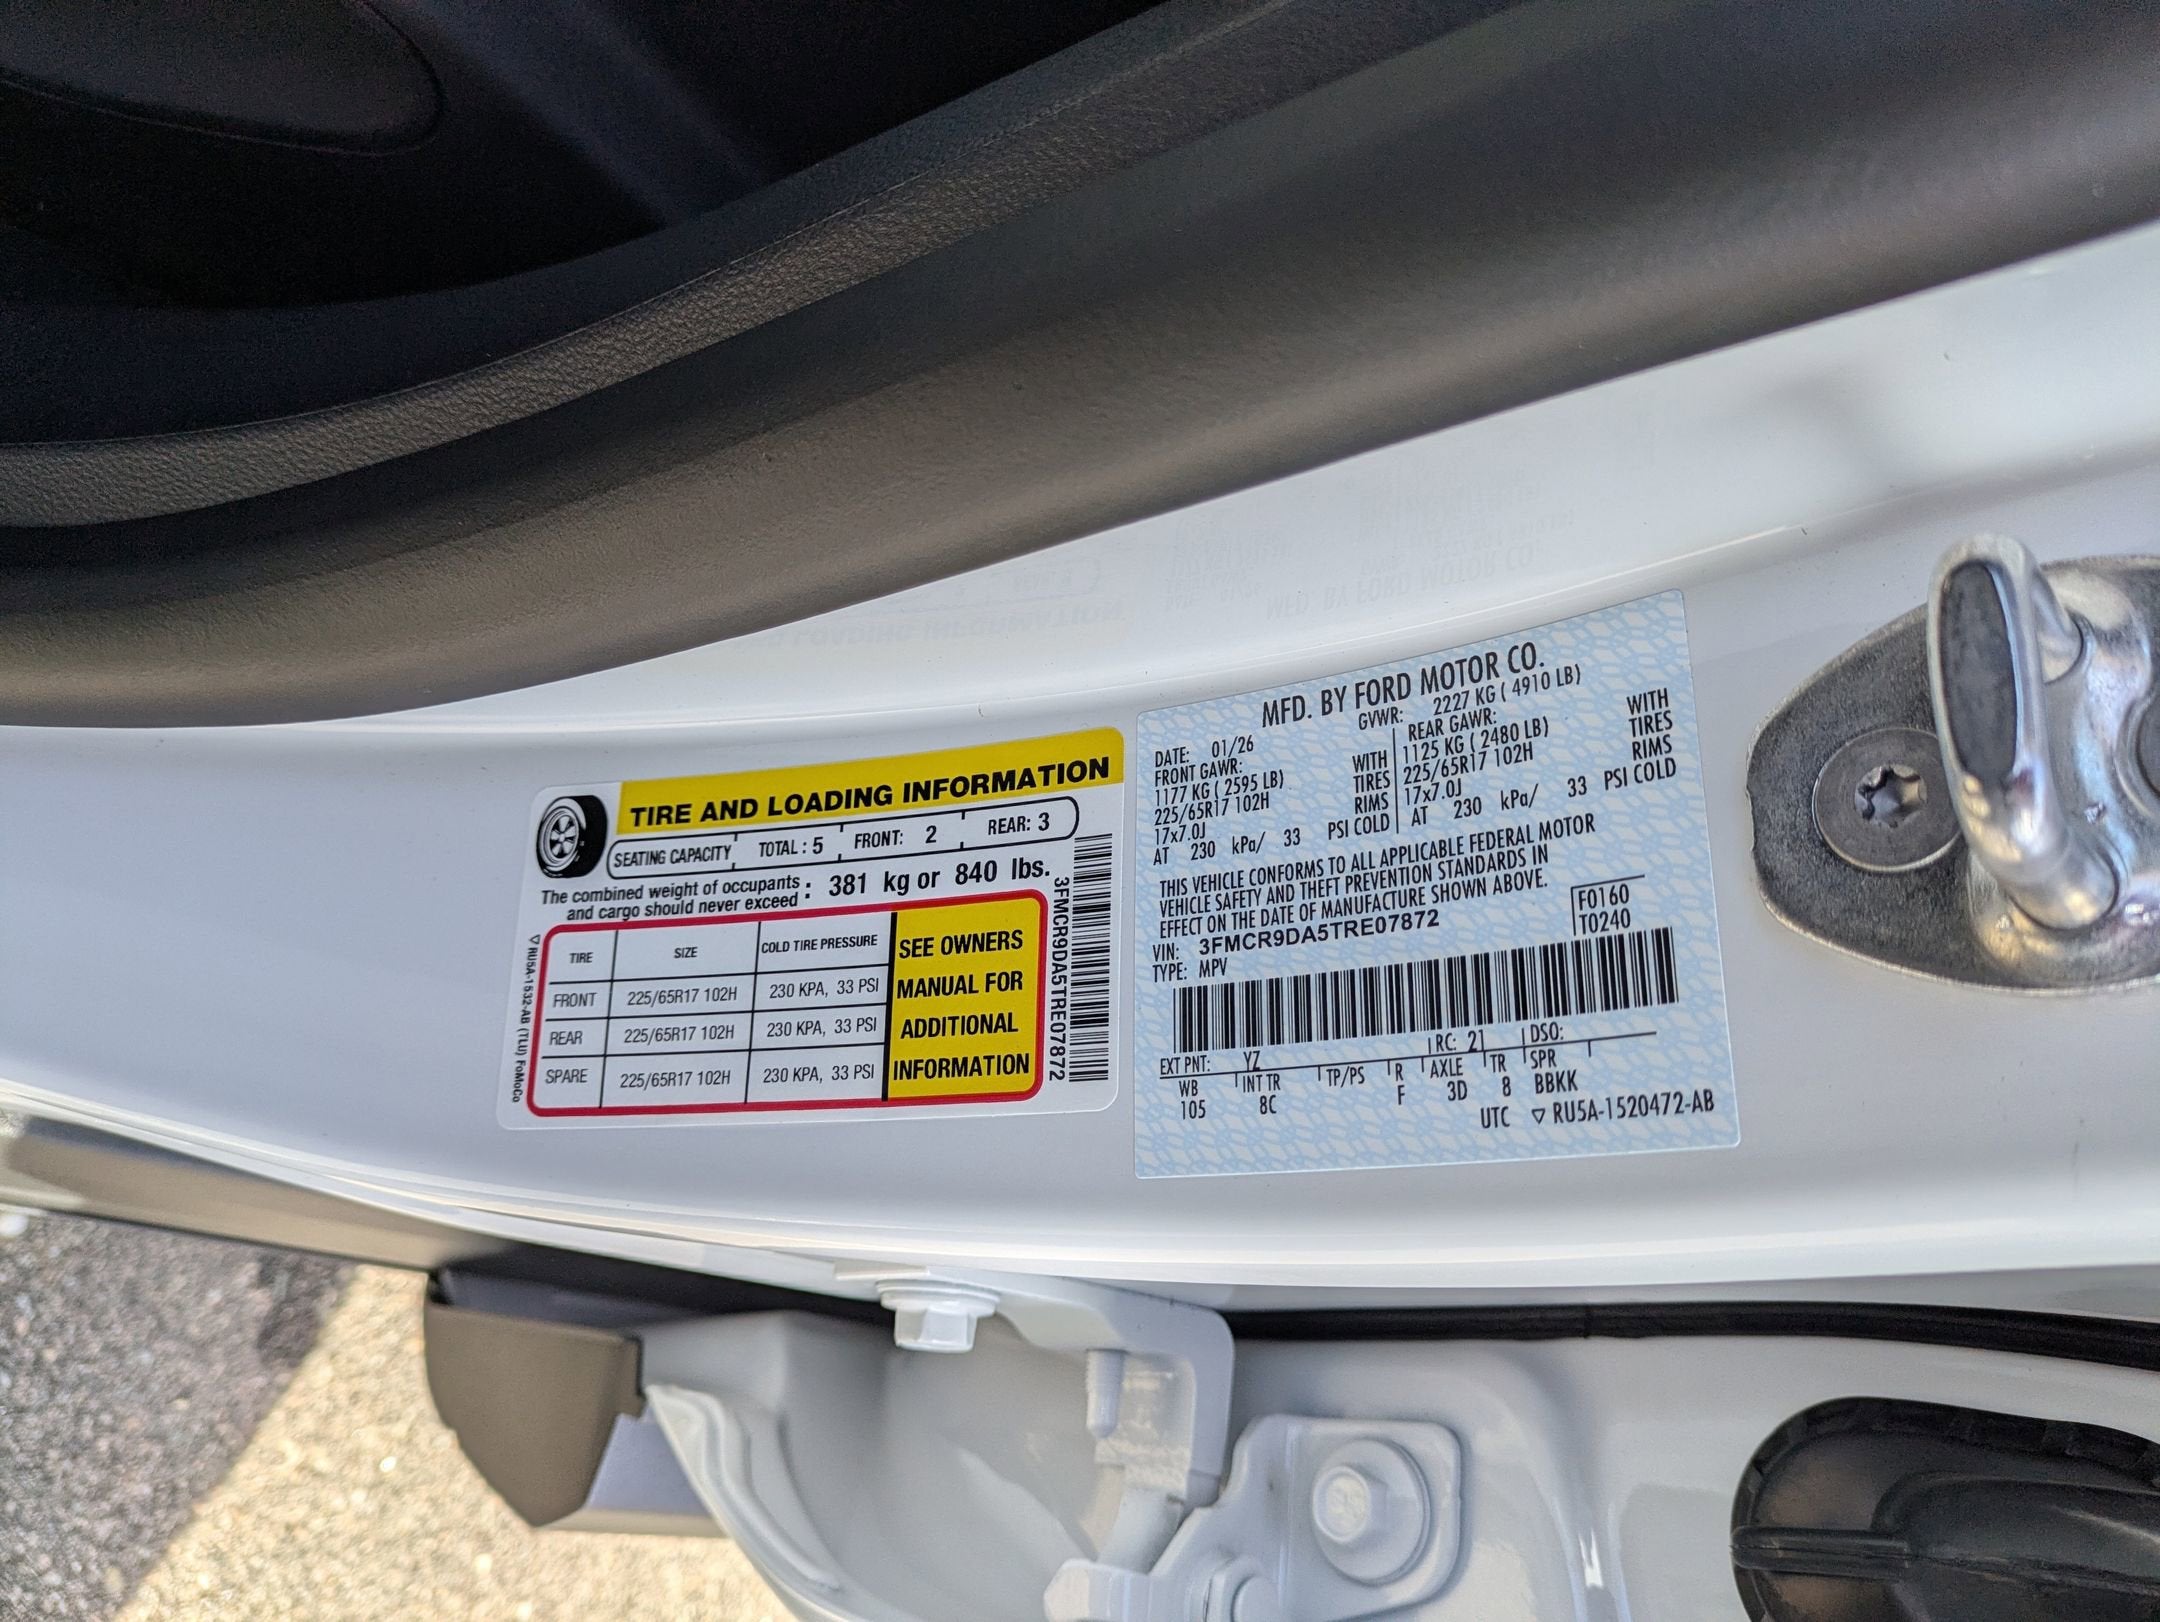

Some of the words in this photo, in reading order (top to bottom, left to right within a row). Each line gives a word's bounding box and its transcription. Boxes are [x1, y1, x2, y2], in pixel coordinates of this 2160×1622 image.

[1262, 695, 1312, 728] MFD.
[1321, 685, 1347, 716] BY
[1355, 672, 1411, 709] FORD
[1420, 652, 1500, 696] MOTOR
[1507, 642, 1544, 674] CO.
[1358, 706, 1403, 730] GVWR:
[1433, 690, 1470, 716] 2227
[1475, 685, 1496, 706] KG
[1556, 663, 1581, 687] LB)
[1626, 687, 1669, 715] WITH
[1403, 739, 1439, 764] 1125
[1445, 735, 1464, 756] KG
[1524, 716, 1549, 739] LB)
[1408, 718, 1445, 742] REAR
[1449, 707, 1497, 733] GAWR:
[1628, 710, 1673, 738] TIRES
[1155, 746, 1190, 768] DATE:
[1211, 734, 1254, 758] 01/26
[1352, 749, 1387, 773] WITH
[1403, 750, 1487, 785] 225/65R17
[1494, 741, 1533, 767] 102H
[1632, 734, 1672, 761] RIMS
[1155, 764, 1196, 787] FRONT
[1200, 757, 1243, 780] GAWR:
[1155, 785, 1188, 807] 1177
[1192, 782, 1210, 801] KG
[1263, 769, 1284, 790] LB)
[1353, 770, 1391, 794] TIRES
[1453, 796, 1482, 819] 230
[1500, 783, 1539, 811] kPa/
[1567, 775, 1587, 798] 33
[1604, 766, 1628, 791] PSI
[1634, 757, 1676, 784] COLD
[630, 803, 692, 827] TIRE
[699, 798, 759, 822] AND
[767, 784, 893, 817] LOADING
[903, 756, 1109, 803] INFORMATION
[1154, 798, 1229, 826] 225/65R17
[1235, 791, 1269, 814] 102H
[1354, 791, 1389, 815] RIMS
[1405, 778, 1462, 806] 17x7.0J
[614, 850, 666, 868] SEATING
[670, 845, 732, 864] CAPACITY
[812, 836, 824, 855] 5
[854, 829, 903, 849] FRONT:
[925, 825, 937, 844] 2
[988, 815, 1031, 836] REAR:
[1038, 812, 1050, 831] 3
[1155, 821, 1206, 846] 17x7.0J
[1190, 840, 1216, 861] 230
[1232, 831, 1266, 855] kPa/
[1284, 827, 1301, 847] 33
[1328, 819, 1349, 840] PSI
[1354, 813, 1390, 836] COLD
[1159, 877, 1188, 898] THIS
[1192, 870, 1244, 894] VEHICLE
[1249, 858, 1324, 887] CONFORMS
[1350, 851, 1376, 872] ALL
[1379, 835, 1465, 868] APPLICABLE
[1469, 824, 1535, 854] FEDERAL
[1539, 813, 1596, 842] MOTOR
[541, 890, 568, 904] The
[572, 885, 644, 903] combined
[649, 882, 699, 901] weight
[702, 879, 719, 895] of
[829, 872, 866, 897] 381
[883, 871, 910, 896] kg
[917, 871, 941, 889] or
[955, 860, 998, 885] 840
[1011, 857, 1050, 880] lbs.
[1159, 894, 1211, 918] VEHICLE
[1215, 887, 1262, 912] SAFETY
[1266, 883, 1295, 905] AND
[1299, 876, 1341, 900] THEFT
[1345, 862, 1432, 894] PREVENTION
[1438, 847, 1526, 880] STANDARDS
[566, 905, 594, 921] and
[598, 904, 641, 921] cargo
[644, 899, 694, 917] should
[698, 899, 741, 913] never
[745, 891, 799, 910] exceed
[1160, 916, 1203, 939] EFFECT
[1207, 913, 1226, 933] ON
[1231, 910, 1256, 931] THE
[1261, 904, 1294, 927] DATE
[1321, 886, 1426, 919] MANUFACTURE
[1431, 876, 1487, 904] SHOWN
[1493, 867, 1548, 895] ABOVE.
[570, 952, 593, 963] TIRE
[674, 946, 698, 959] SIZE
[761, 941, 790, 954] COLD
[793, 938, 818, 952] TIRE
[820, 934, 878, 950] PRESSURE
[899, 937, 934, 959] SEE
[941, 929, 1023, 956] OWNERS
[1152, 942, 1179, 962] VIN:
[1199, 908, 1439, 955] 3FMCR9DA5TRE07872
[897, 974, 979, 999] MANUAL
[985, 970, 1023, 993] FOR
[1048, 876, 1070, 1082] 3FMCR9DA5TRE07872
[1152, 962, 1187, 983] TYPE:
[1199, 957, 1228, 978] MPV
[553, 992, 597, 1007] FRONT
[627, 988, 700, 1008] 225/65R17
[704, 986, 737, 1002] 102H
[769, 983, 795, 999] 230
[799, 981, 828, 998] KPA,
[837, 979, 854, 995] 33
[858, 977, 879, 993] PSI
[515, 1028, 529, 1056] (TLU)
[549, 1031, 583, 1045] REAR
[624, 1026, 697, 1045] 225/65R17
[701, 1025, 734, 1040] 102H
[767, 1021, 792, 1037] 230
[796, 1020, 826, 1037] KPA,
[834, 1018, 852, 1034] 33
[856, 1016, 877, 1032] PSI
[900, 1012, 1019, 1039] ADDITIONAL
[1160, 1057, 1181, 1075] EXT
[1184, 1054, 1210, 1074] PNT:
[1244, 1050, 1261, 1071] YZ
[1436, 1032, 1457, 1052] RC:
[1530, 1021, 1564, 1043] DSO:
[512, 1060, 526, 1103] FoMoCo
[545, 1069, 588, 1084] SPARE
[620, 1071, 693, 1091] 225/65R17
[697, 1070, 731, 1085] 102H
[763, 1068, 789, 1083] 230
[793, 1066, 822, 1084] KPA,
[831, 1065, 849, 1081] 33
[854, 1063, 874, 1080] PSI
[893, 1053, 1029, 1081] INFORMATION
[1178, 1079, 1198, 1097] WB
[1243, 1074, 1263, 1093] INT
[1326, 1066, 1365, 1088] TP/PS
[1430, 1057, 1463, 1079] AXLE
[1530, 1048, 1557, 1069] SPR
[1181, 1099, 1206, 1120] 105
[1260, 1094, 1277, 1115] 8C
[1534, 1069, 1578, 1094] BBKK
[1480, 1106, 1510, 1129] UTC
[1553, 1089, 1715, 1124] RU5A-1520472-AB
